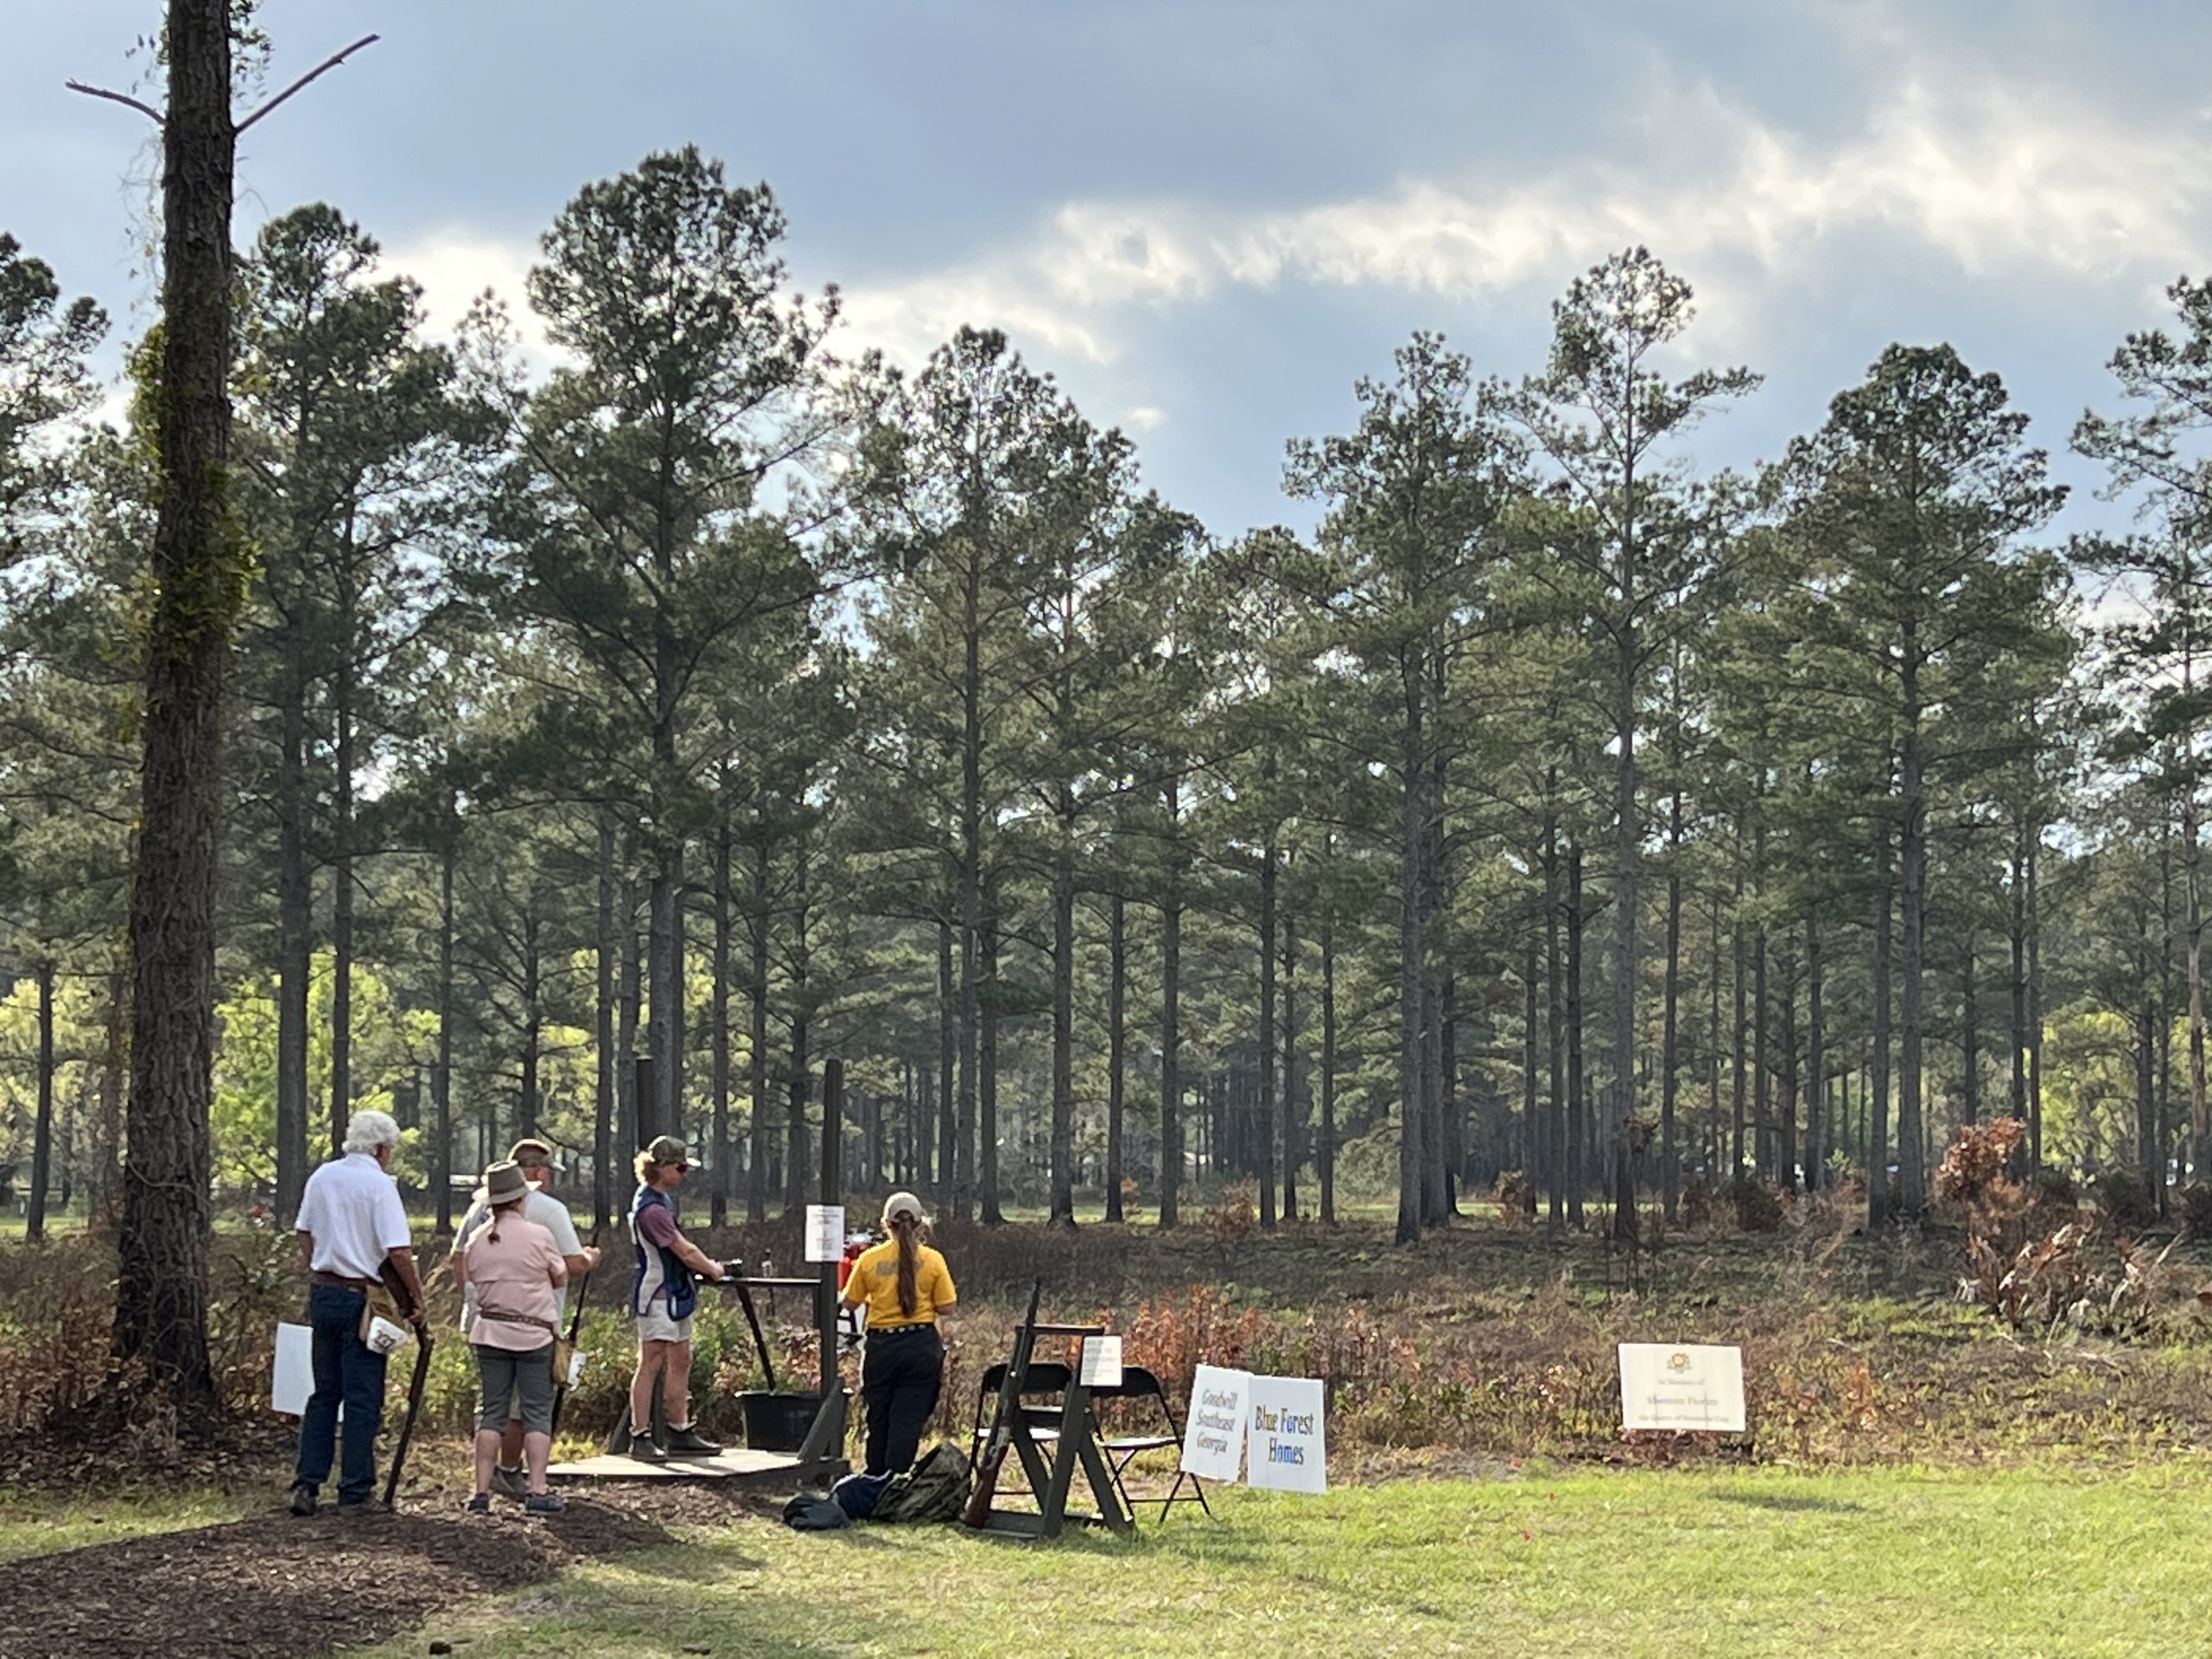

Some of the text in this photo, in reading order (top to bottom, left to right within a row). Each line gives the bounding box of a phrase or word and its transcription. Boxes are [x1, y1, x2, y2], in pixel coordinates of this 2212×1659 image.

[1202, 1388, 1238, 1410] Goodwill
[1196, 1408, 1236, 1432] Southeast
[1255, 1404, 1314, 1435] Blue Forest
[1197, 1431, 1228, 1456] Georgia
[1268, 1437, 1305, 1465] Homes
